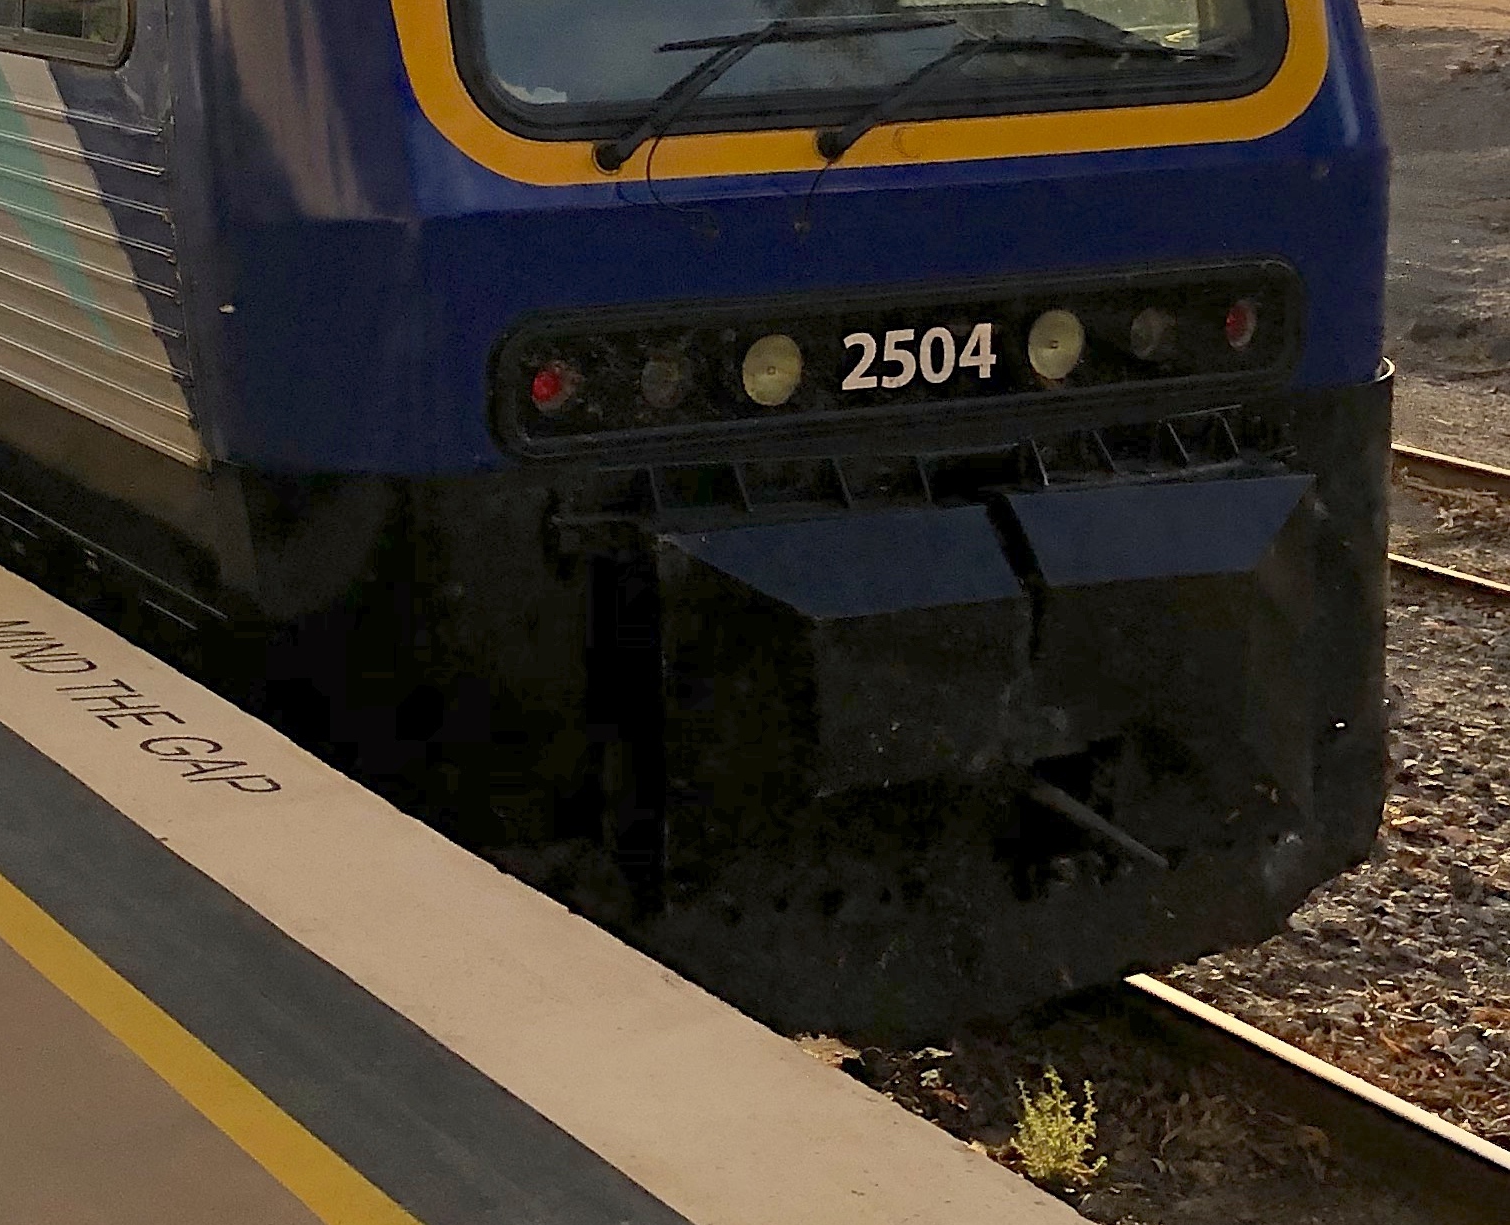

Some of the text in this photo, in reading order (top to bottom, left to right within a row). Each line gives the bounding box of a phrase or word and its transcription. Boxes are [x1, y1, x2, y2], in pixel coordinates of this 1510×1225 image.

[842, 322, 996, 390] 2504
[56, 678, 186, 729] THE
[140, 736, 282, 792] GAP
